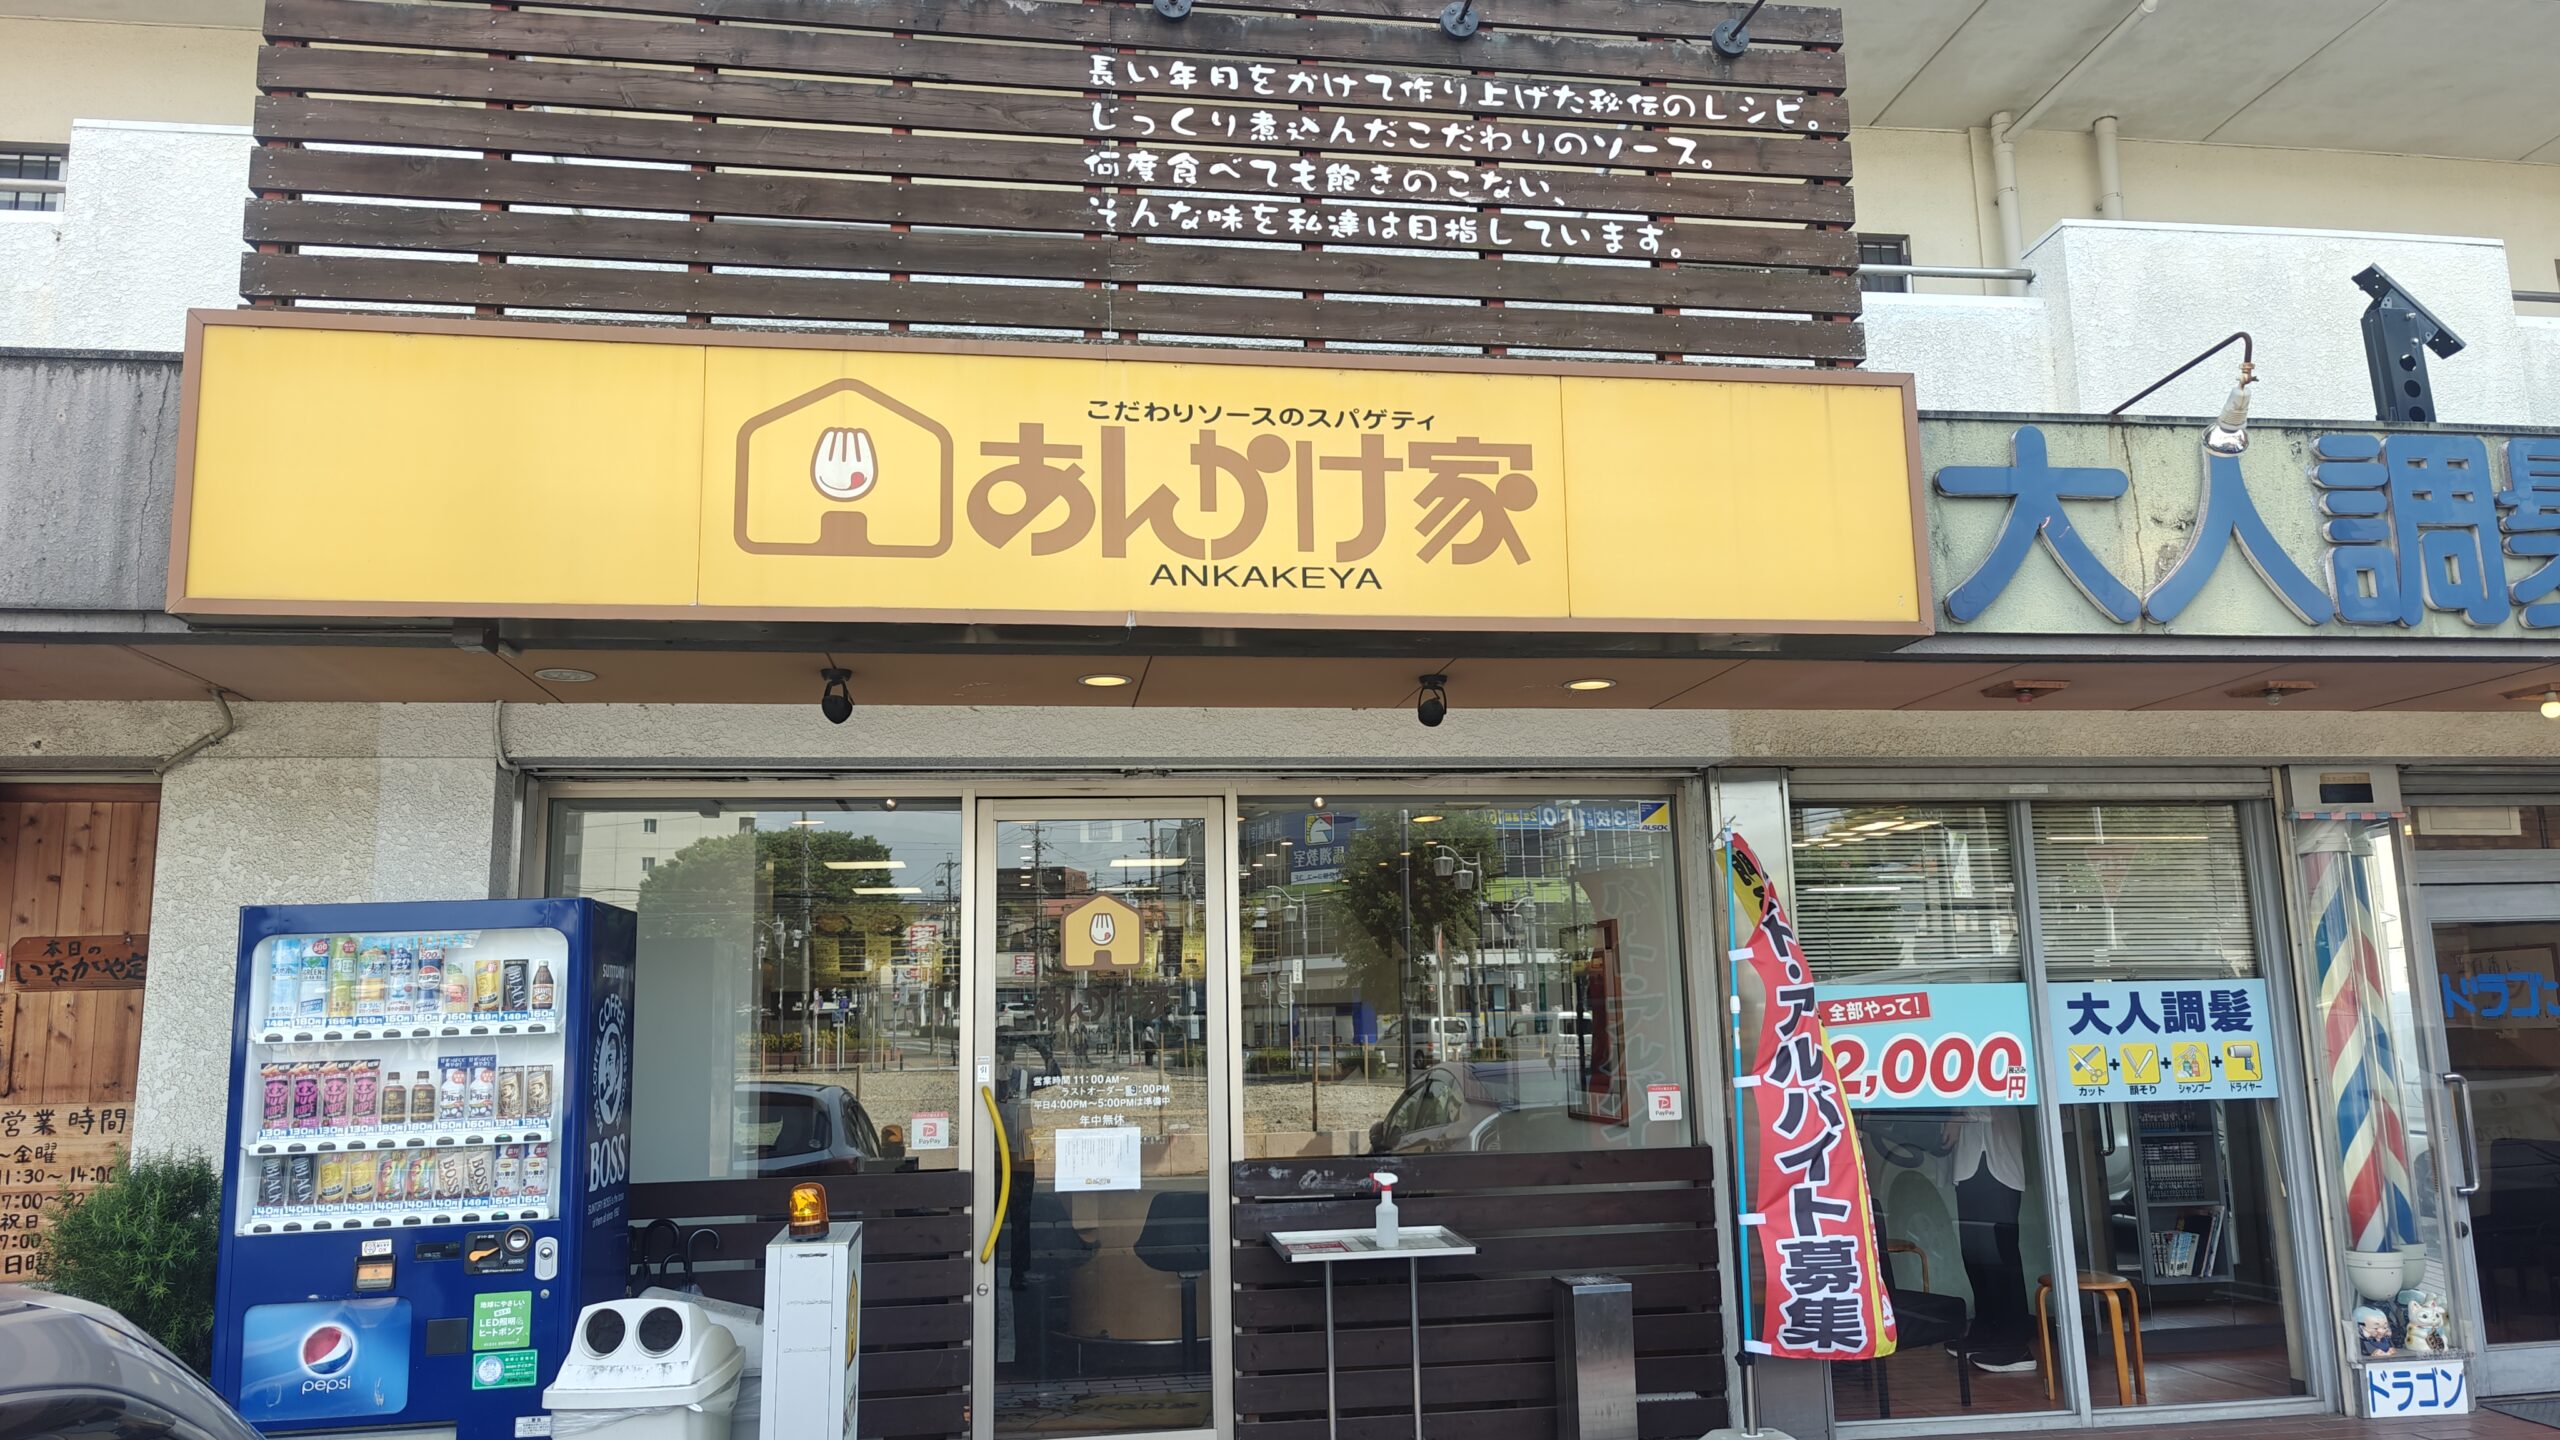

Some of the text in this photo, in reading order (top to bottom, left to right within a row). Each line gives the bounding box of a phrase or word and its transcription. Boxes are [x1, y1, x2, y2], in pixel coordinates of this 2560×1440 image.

[1089, 55, 1821, 131] 長い年月をかけて作り上げた秘伝のレシピ。
[1091, 102, 1713, 169] じっくり煮込んだこだわりのソース。
[1084, 150, 1566, 206] 何度食べても飽きのこない、
[1091, 196, 1684, 258] そんな味を私達は目指しています。
[1088, 400, 1436, 432] こだわりソースのスパゲティ
[967, 421, 1539, 567] あんかけ家
[1149, 563, 1383, 590] ANKAKEYA
[1641, 824, 1669, 832] ALSOK
[42, 940, 102, 957] 本日の
[599, 993, 625, 1033] COFFEE
[1829, 996, 1921, 1022] 全部やって!
[2067, 989, 2254, 1036] 大人調髪
[1033, 1076, 1071, 1087] 営業時間
[1061, 1087, 1124, 1096] ラストオーダー
[2079, 1087, 2105, 1097] カット
[2129, 1085, 2157, 1096] 顔そり
[2178, 1084, 2211, 1093] シャンプー
[2229, 1082, 2262, 1092] ドライヤー
[1, 1106, 126, 1138] 営業時間
[1079, 1114, 1125, 1126] 年中無休
[472, 1158, 489, 1193] BOSS
[588, 1133, 625, 1192] BOSS
[443, 1160, 460, 1195] BOSS
[1, 1213, 38, 1232] 祝日
[480, 1299, 525, 1309] 地球にやさしい
[479, 1326, 524, 1337] ヒートポンプ
[302, 1376, 351, 1395] pepsi
[2368, 1366, 2463, 1413] ドラゴン
